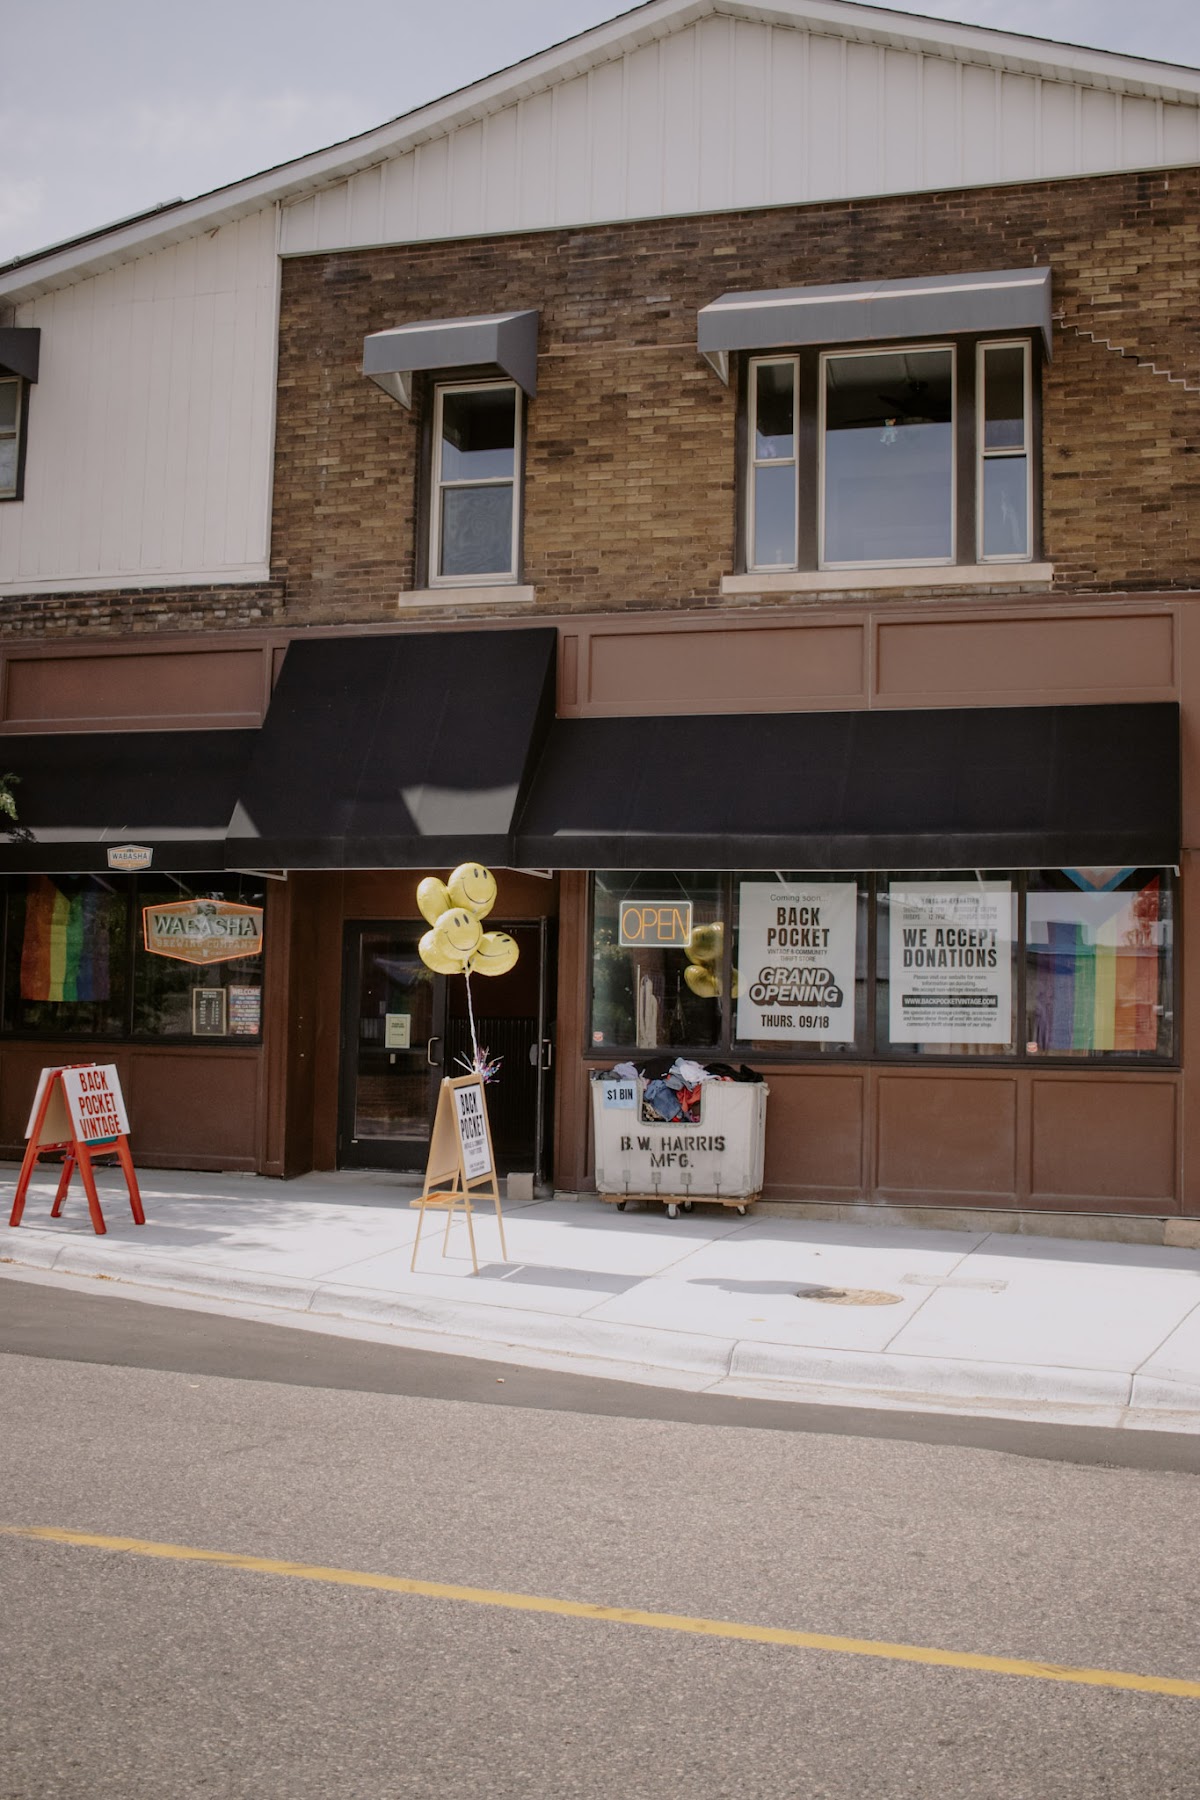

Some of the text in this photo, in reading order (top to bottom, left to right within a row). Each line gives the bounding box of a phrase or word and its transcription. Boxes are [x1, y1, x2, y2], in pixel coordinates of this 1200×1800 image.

[112, 852, 148, 860] WABASHA
[770, 894, 800, 903] Coming
[154, 915, 258, 936] WABASHA
[622, 907, 689, 939] OPEN
[777, 907, 820, 926] BACK
[207, 940, 255, 949] COMPANY
[767, 928, 830, 947] POCKET
[903, 928, 997, 947] WE ACCEPT
[903, 949, 997, 967] DONATIONS
[759, 967, 833, 985] GRAND
[749, 984, 842, 1005] OPENING
[761, 1014, 829, 1028] THURS. 09/18
[79, 1070, 109, 1092] BACK
[78, 1092, 117, 1116] POCKET
[460, 1091, 478, 1115] BACK
[607, 1089, 633, 1100] $1 BIN
[79, 1114, 122, 1139] VINTAGE
[460, 1114, 485, 1140] POCKET
[661, 1136, 726, 1152] HARRIS
[650, 1153, 694, 1168] MFG.
